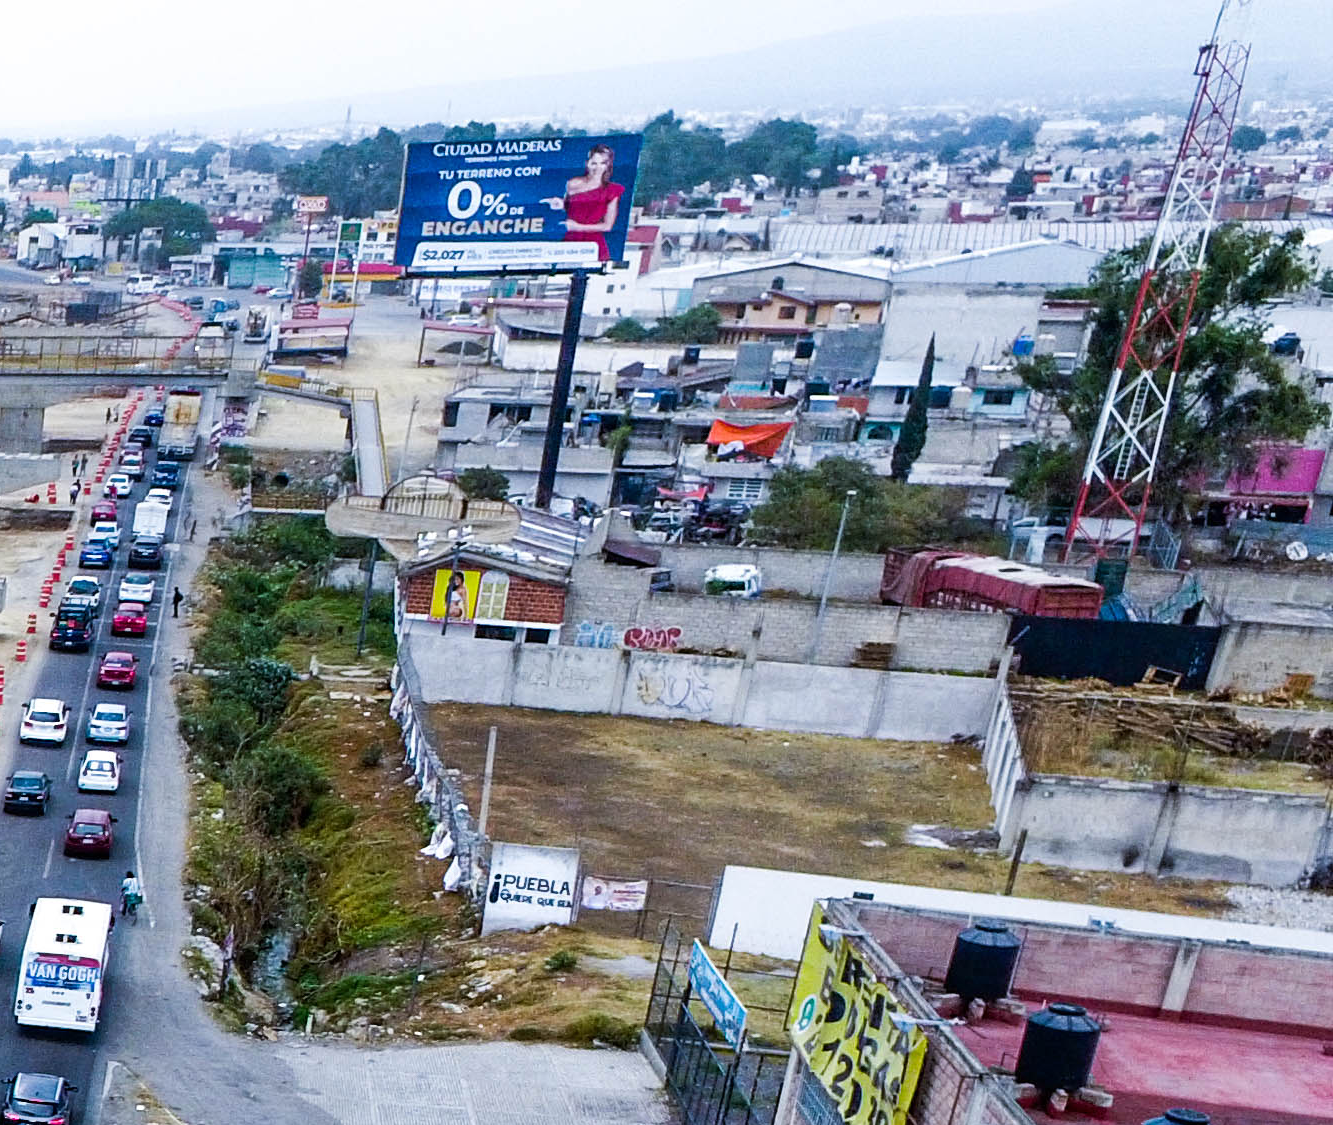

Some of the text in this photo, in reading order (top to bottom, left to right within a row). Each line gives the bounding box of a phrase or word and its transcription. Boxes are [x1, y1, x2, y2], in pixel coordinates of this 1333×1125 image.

[433, 140, 562, 157] CIUDAD MADERAS
[439, 166, 541, 180] TU TERRENO CON
[509, 207, 524, 215] DE
[421, 217, 544, 237] ENGANCHE
[421, 249, 464, 261] $2,027
[29, 962, 97, 983] VAN GOGH
